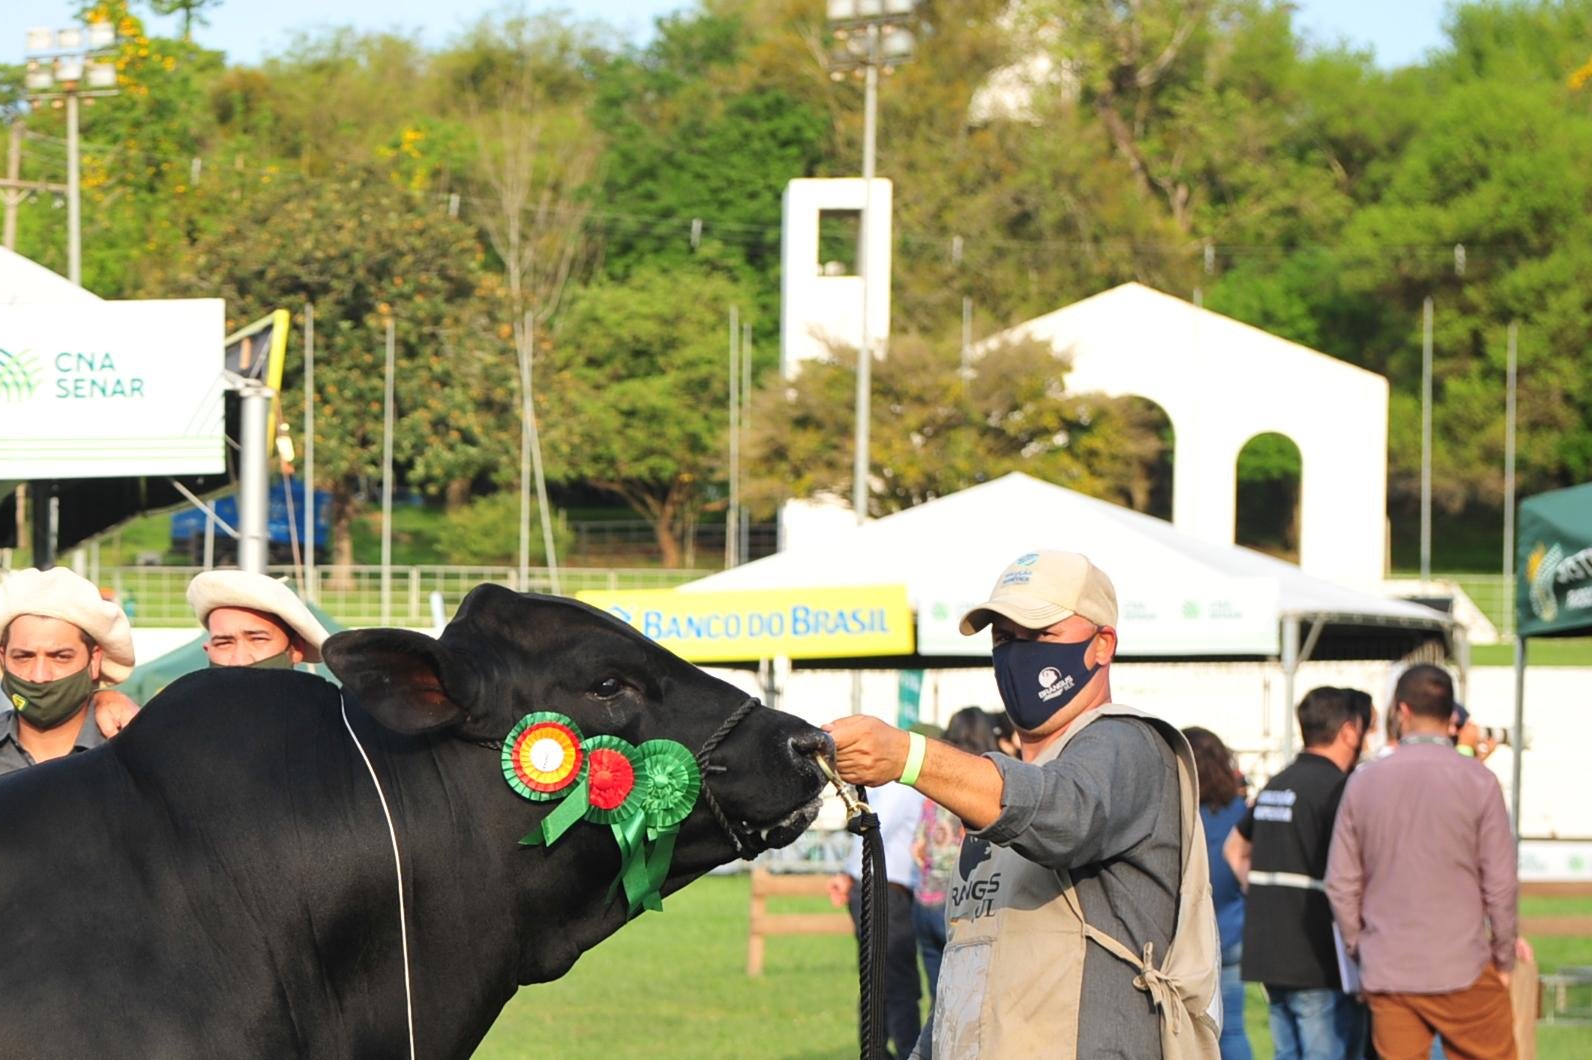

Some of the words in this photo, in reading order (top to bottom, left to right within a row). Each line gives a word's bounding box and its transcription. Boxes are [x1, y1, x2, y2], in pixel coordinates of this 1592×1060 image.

[56, 353, 116, 374] CNA
[57, 378, 145, 400] SENAR
[643, 610, 742, 641] BANCO
[748, 612, 785, 638] DO
[791, 605, 889, 637] BRASIL
